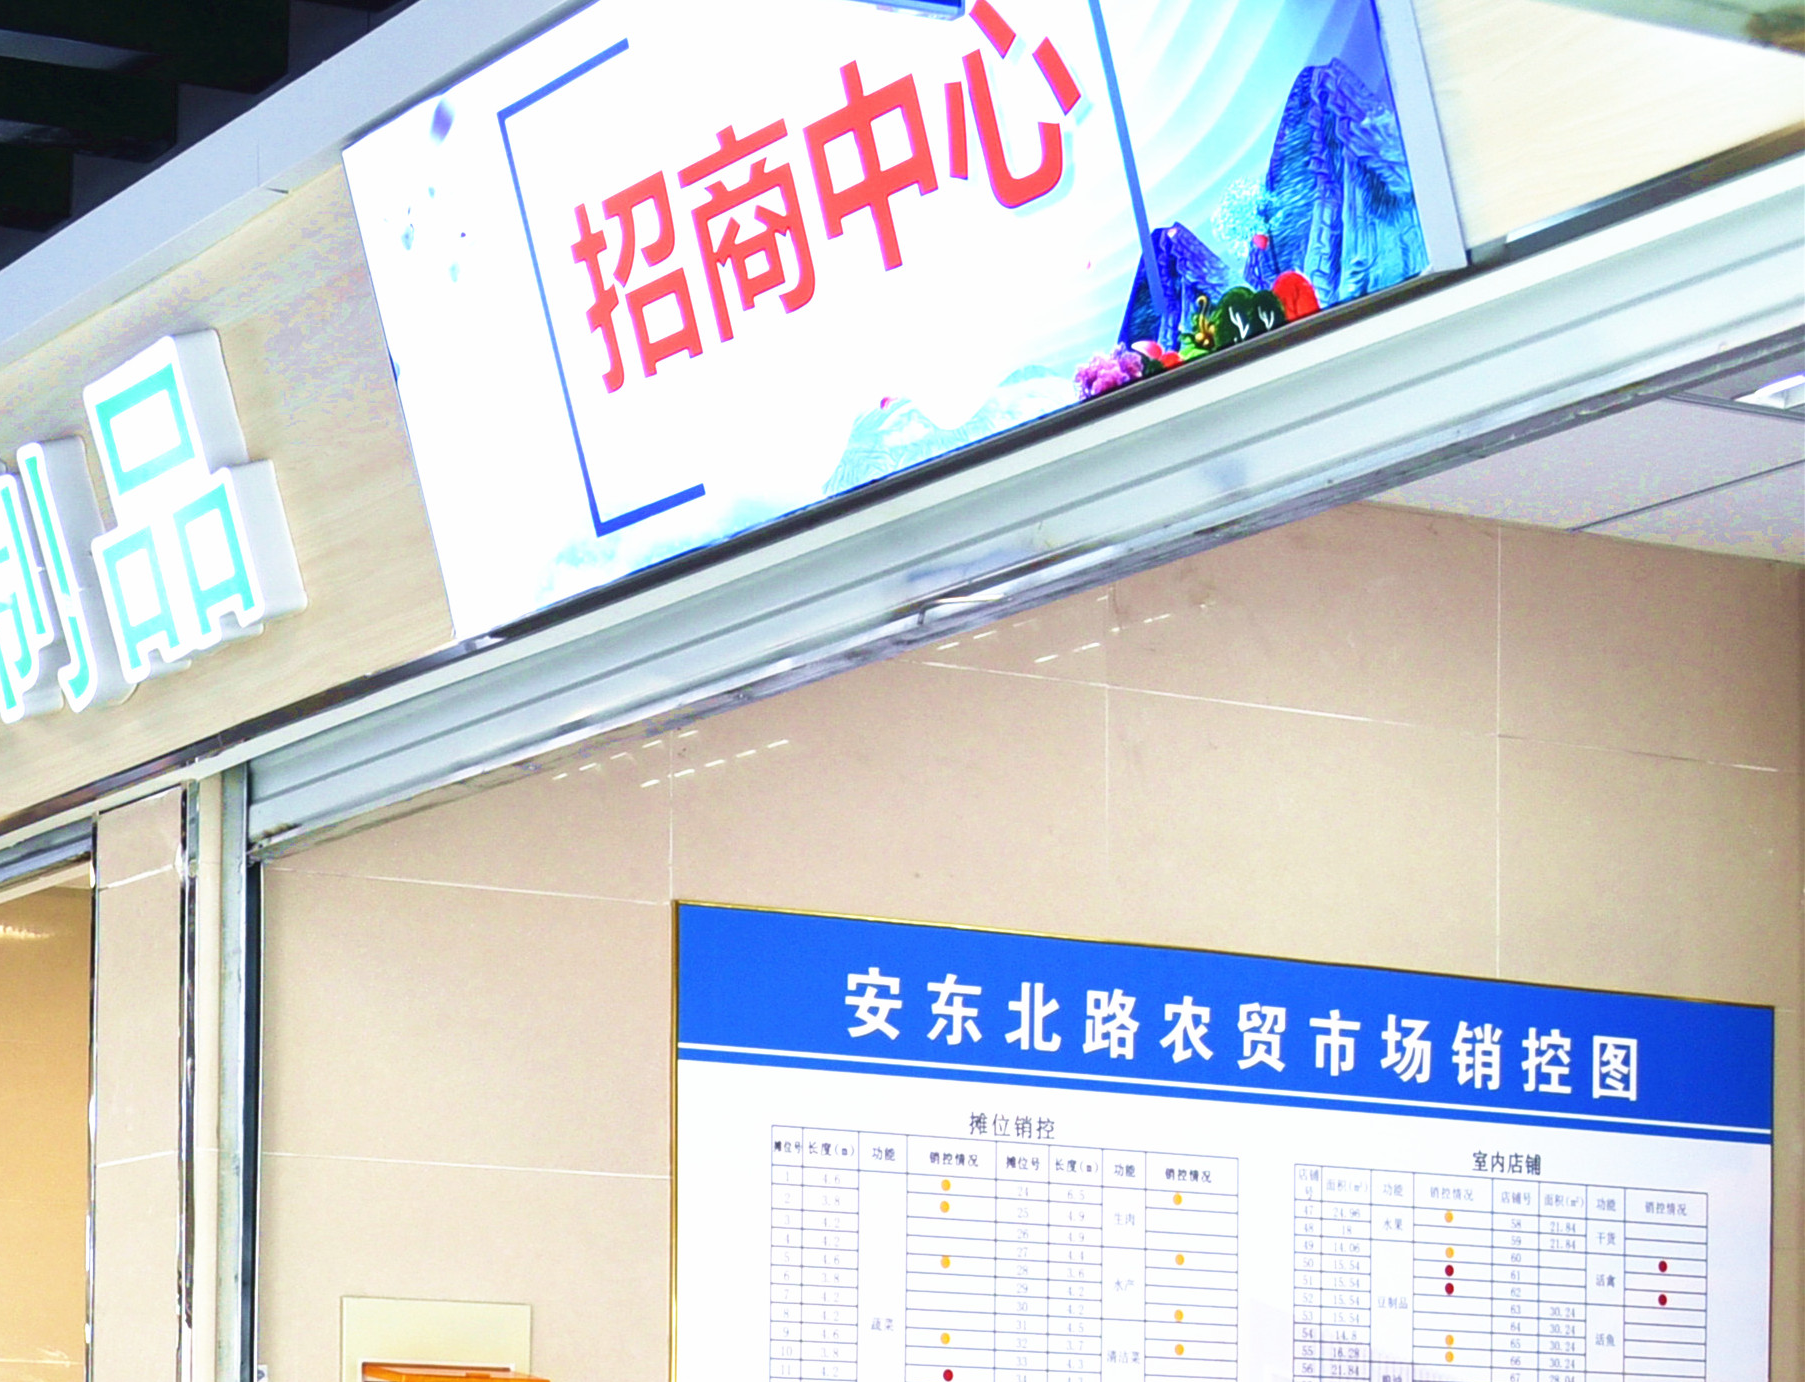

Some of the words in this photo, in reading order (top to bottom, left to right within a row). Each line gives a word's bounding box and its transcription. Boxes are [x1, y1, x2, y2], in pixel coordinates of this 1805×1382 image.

[571, 0, 1081, 393] 招商中心
[844, 967, 1639, 1101] 安东北路农贸市场销控图
[1472, 1148, 1541, 1176] 室内店铺
